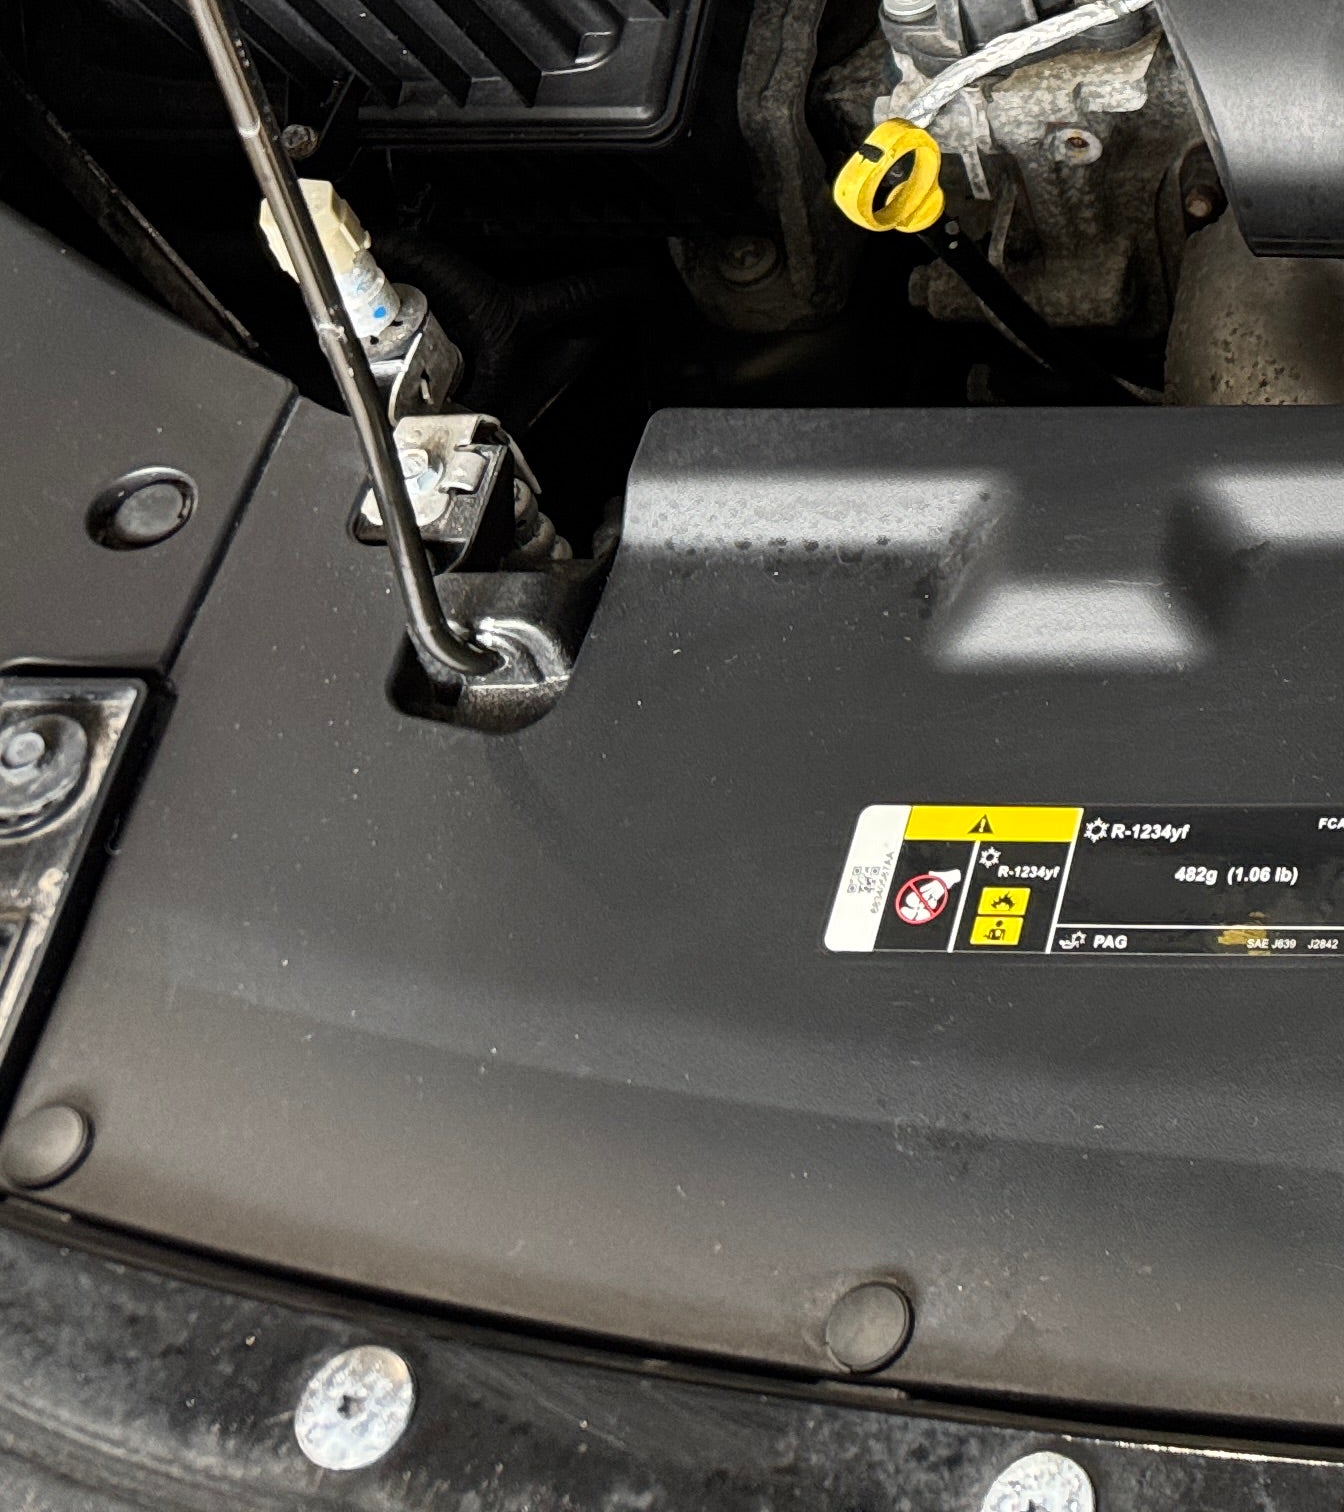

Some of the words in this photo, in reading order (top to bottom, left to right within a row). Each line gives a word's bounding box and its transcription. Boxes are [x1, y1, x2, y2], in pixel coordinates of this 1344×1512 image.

[1110, 822, 1190, 843] R-1234yf
[998, 864, 1061, 880] R-1234yf
[1174, 865, 1218, 887] 482g
[1227, 865, 1272, 887] (1.06
[1274, 865, 1299, 887] lb)
[1092, 933, 1129, 951] PAG
[1246, 938, 1270, 949] SAE
[1270, 938, 1297, 950] J639
[1307, 938, 1339, 950] J2842
